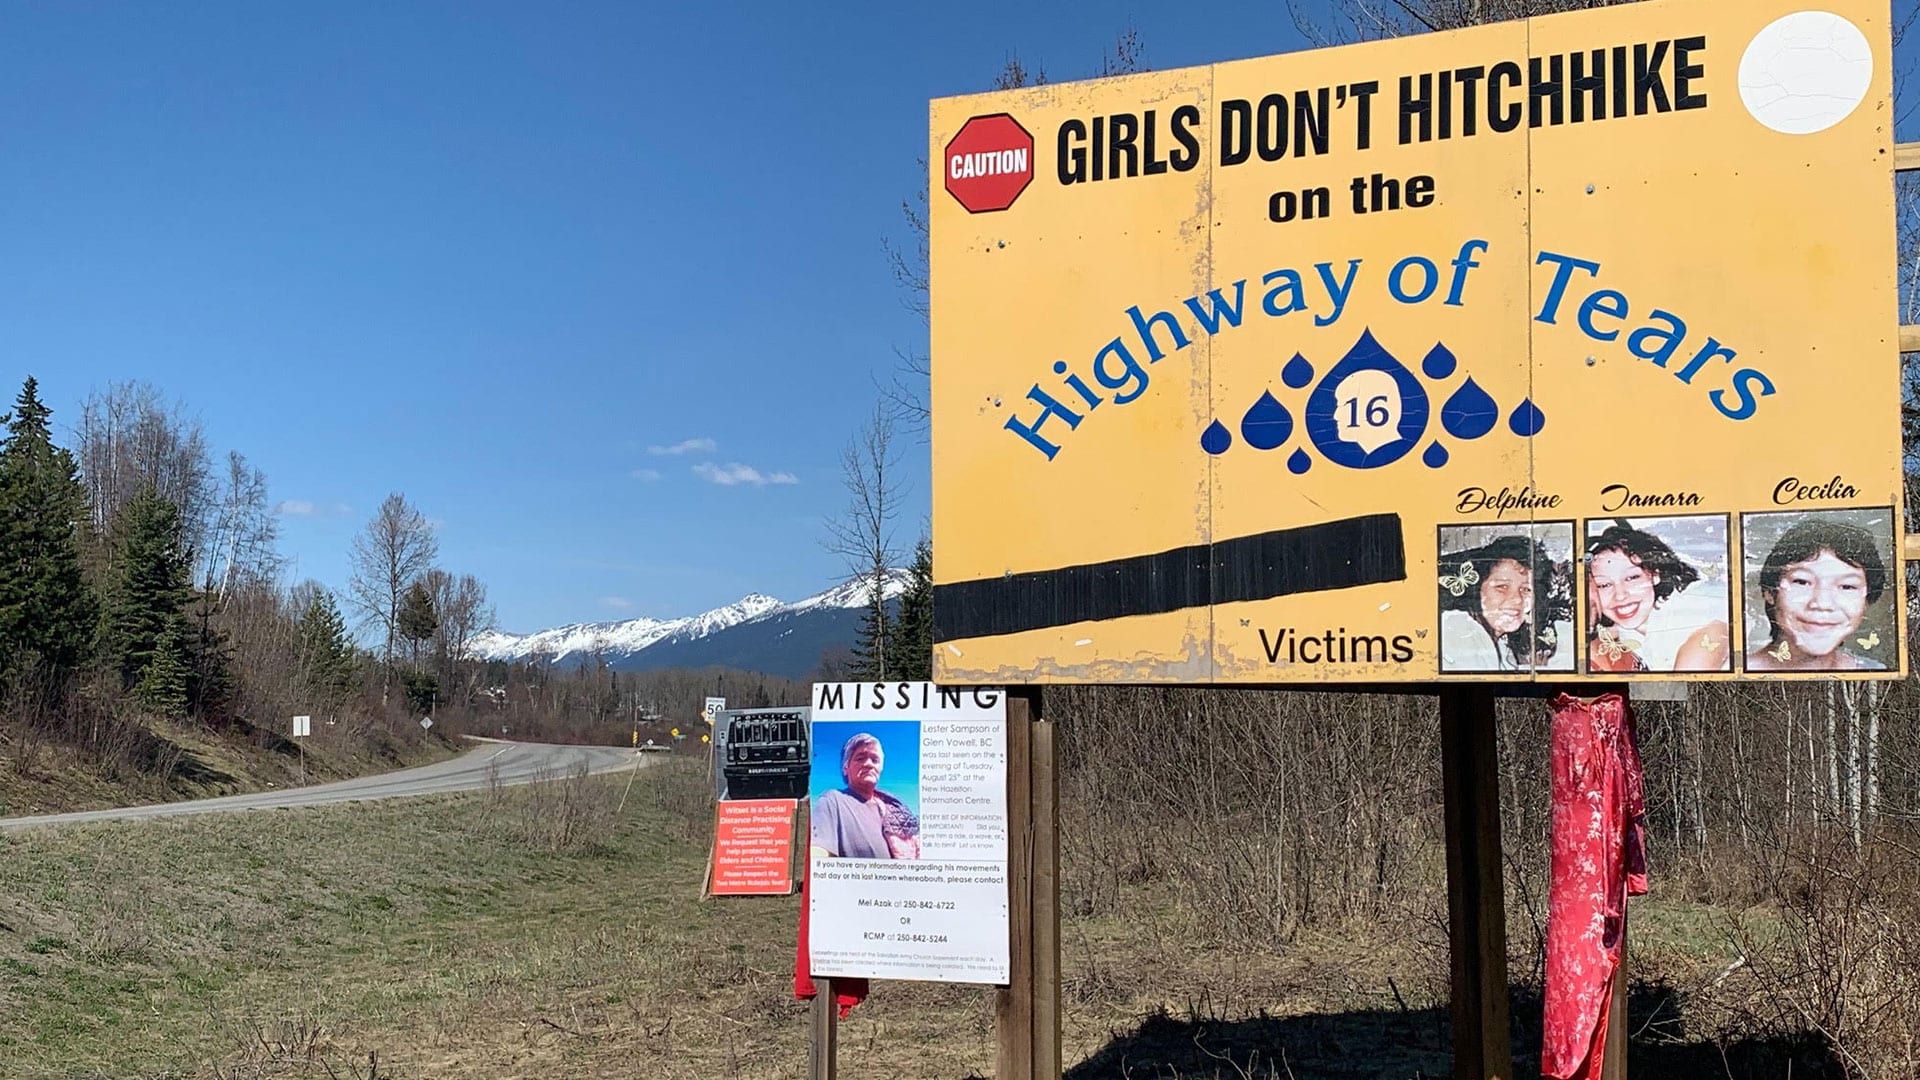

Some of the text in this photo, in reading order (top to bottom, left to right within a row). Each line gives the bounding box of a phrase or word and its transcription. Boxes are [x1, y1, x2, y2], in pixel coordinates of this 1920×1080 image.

[1057, 35, 1708, 186] GIRLS DON'T HITCHHIKE
[950, 147, 1028, 179] CAUTION
[1268, 172, 1435, 223] on the
[1004, 239, 1777, 462] Highway of Tears
[1344, 394, 1390, 428] 16
[1772, 475, 1861, 505] Cecilia
[1455, 486, 1564, 519] Delphine
[1600, 484, 1704, 512] Tamara
[1258, 627, 1414, 664] Victims
[819, 682, 998, 710] MISSING
[923, 724, 1000, 734] Lester Sampson of
[922, 737, 992, 747] Glen Vowell, BC
[922, 762, 951, 771] evening
[953, 762, 961, 770] of
[921, 774, 947, 782] August
[764, 805, 787, 813] Social
[731, 826, 776, 835] Community
[855, 862, 867, 870] any
[869, 862, 906, 870] information
[908, 863, 943, 872] regarding
[828, 872, 841, 880] day
[874, 873, 897, 881] known
[974, 876, 1004, 884] contact
[874, 899, 892, 907] Azak
[894, 900, 902, 908] at
[903, 900, 955, 910] 250-842-6722
[900, 916, 911, 925] OR
[863, 932, 948, 943] RCMP at 250-842-5244
